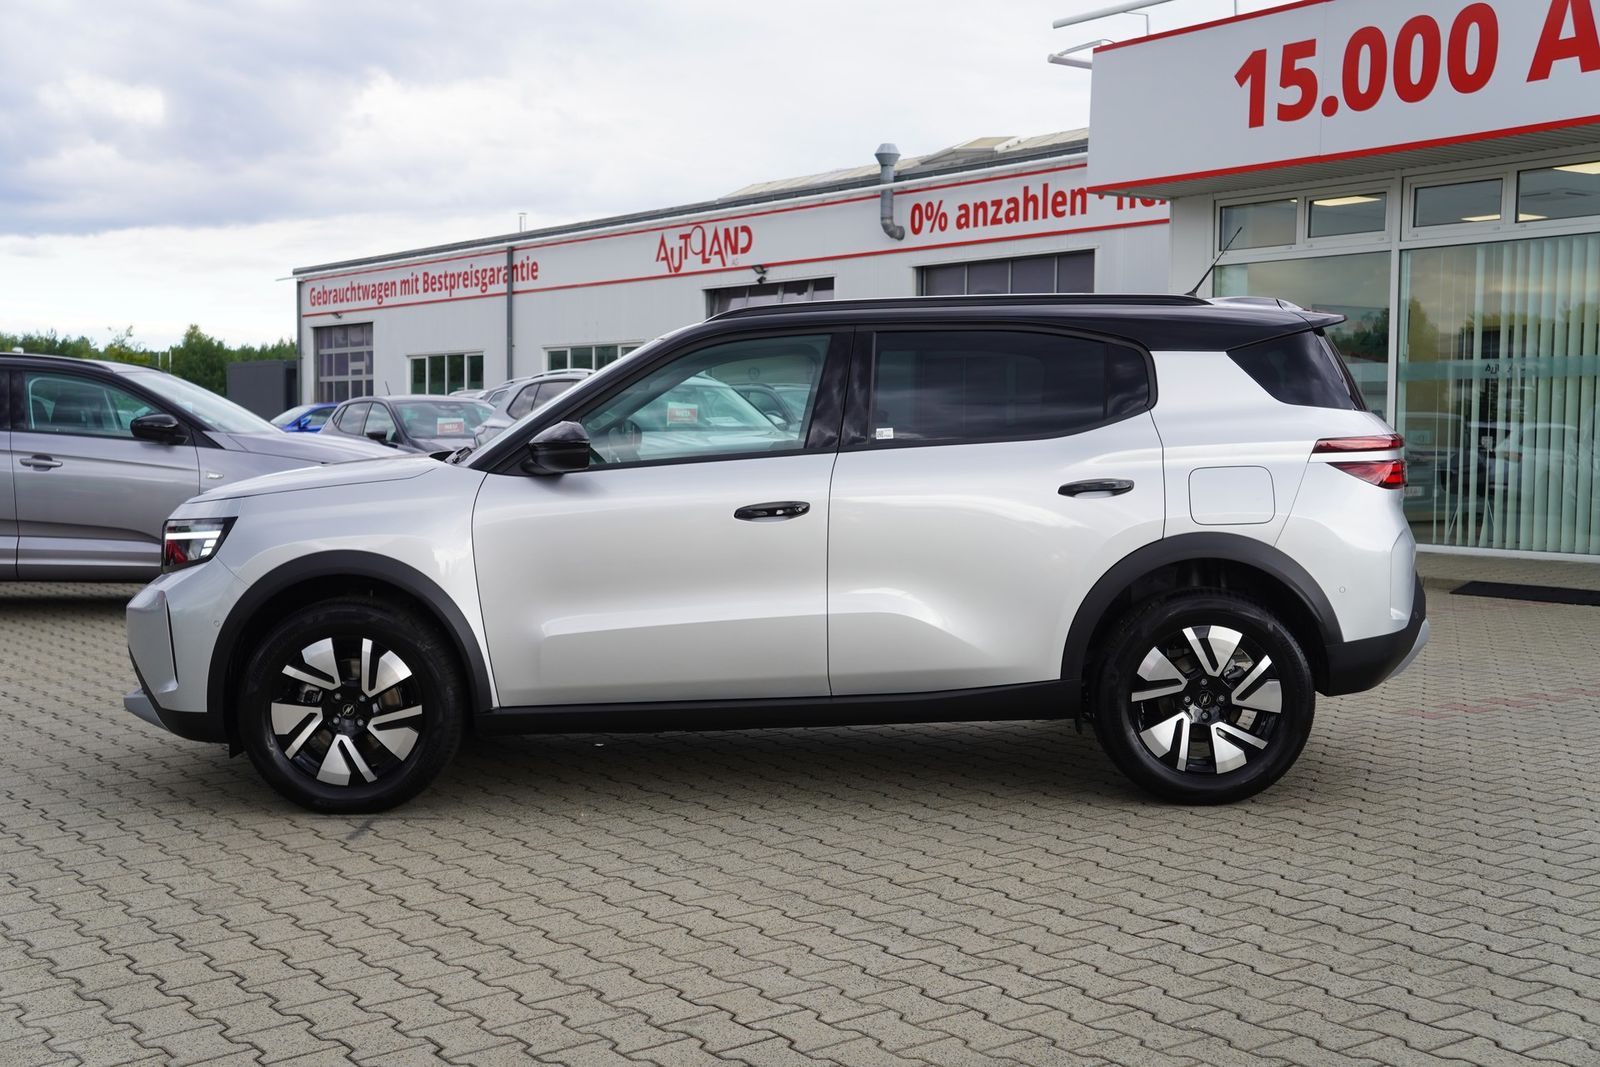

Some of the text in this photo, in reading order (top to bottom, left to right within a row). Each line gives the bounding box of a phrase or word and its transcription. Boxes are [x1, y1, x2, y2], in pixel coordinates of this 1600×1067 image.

[1234, 2, 1499, 129] 15.000
[910, 199, 948, 236] 0%
[955, 183, 1088, 230] anzahlen
[655, 225, 753, 273] AUTOLAND
[309, 256, 539, 306] Gebrauchtwagen mit Bestpreisgarantie
